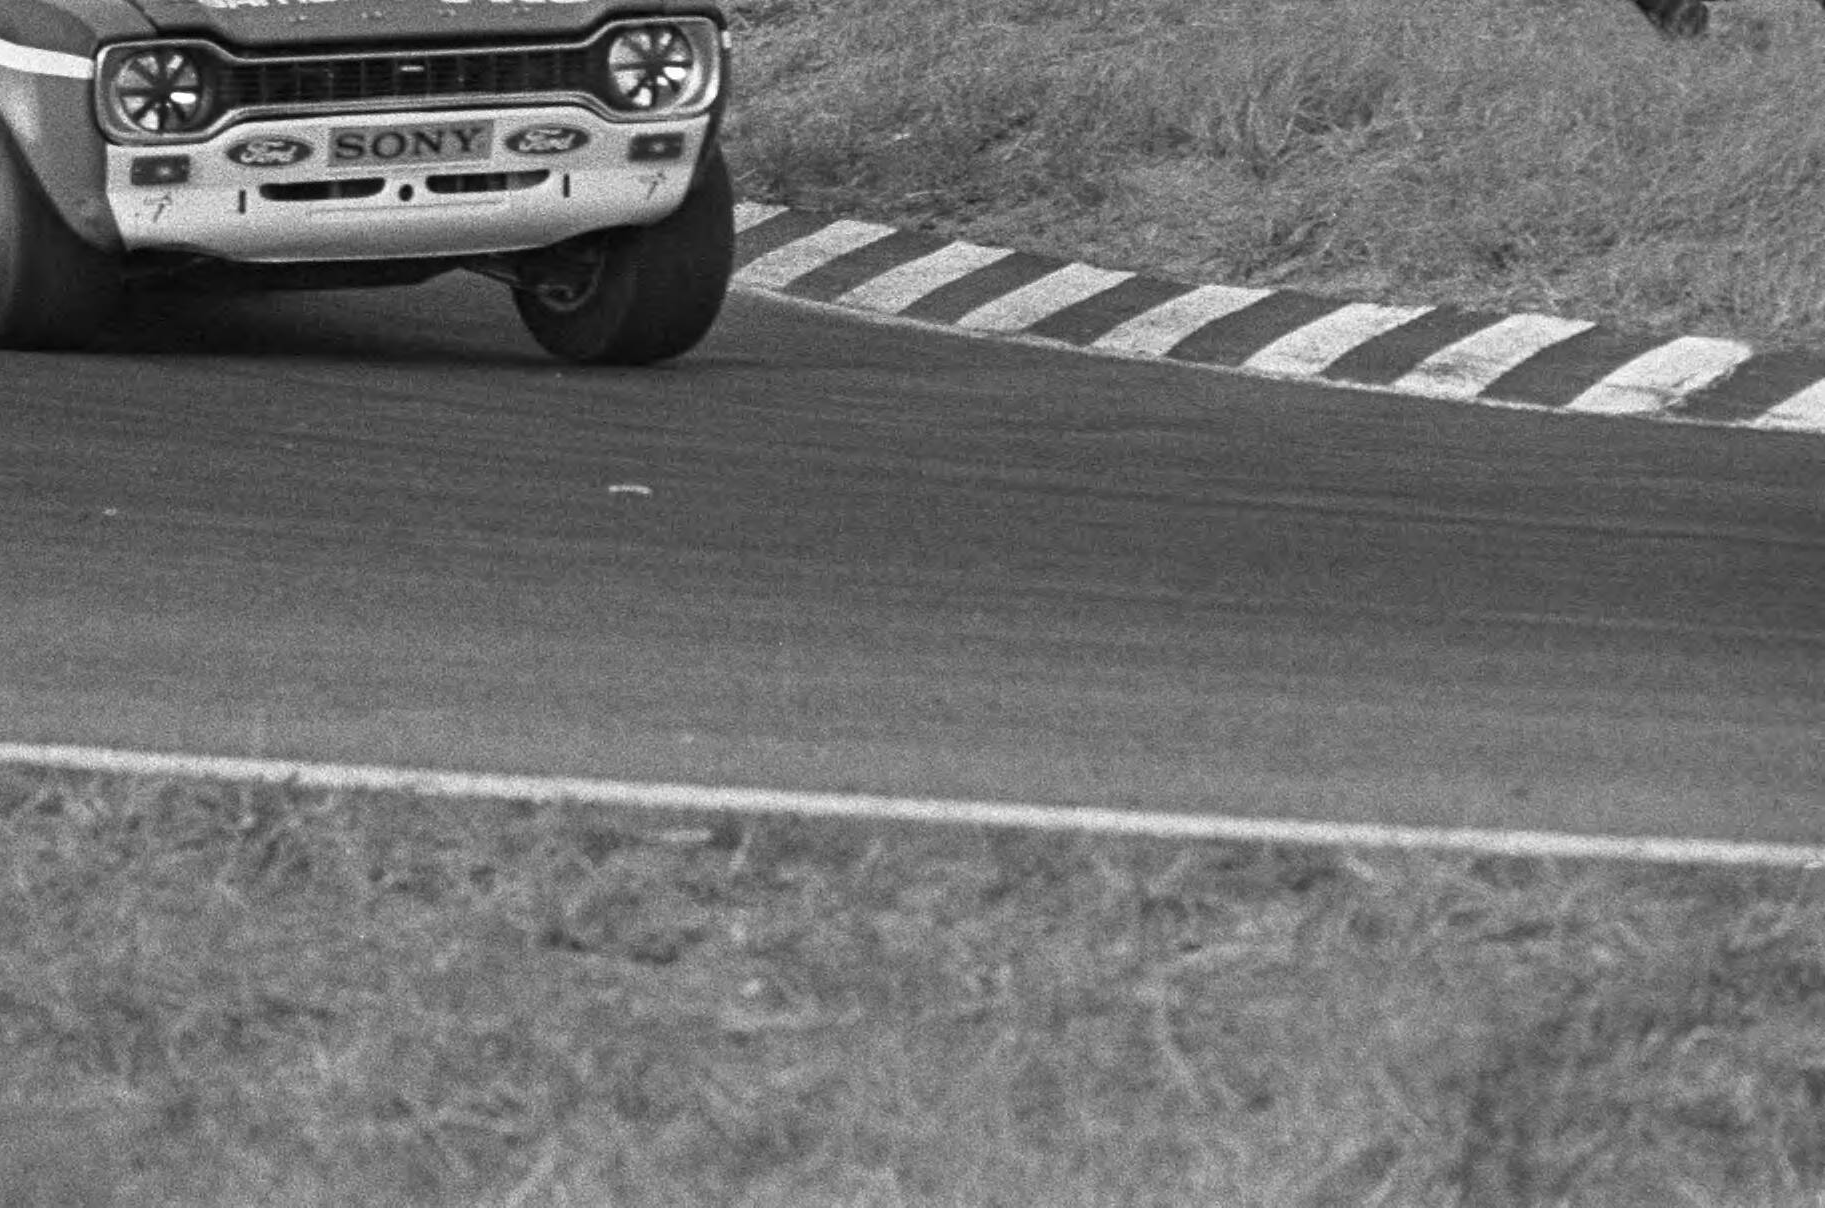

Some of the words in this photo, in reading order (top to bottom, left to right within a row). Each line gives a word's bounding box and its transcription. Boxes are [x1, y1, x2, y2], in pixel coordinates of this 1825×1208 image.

[240, 140, 297, 164] Ford
[335, 127, 480, 161] SONY
[518, 129, 576, 152] Ford
